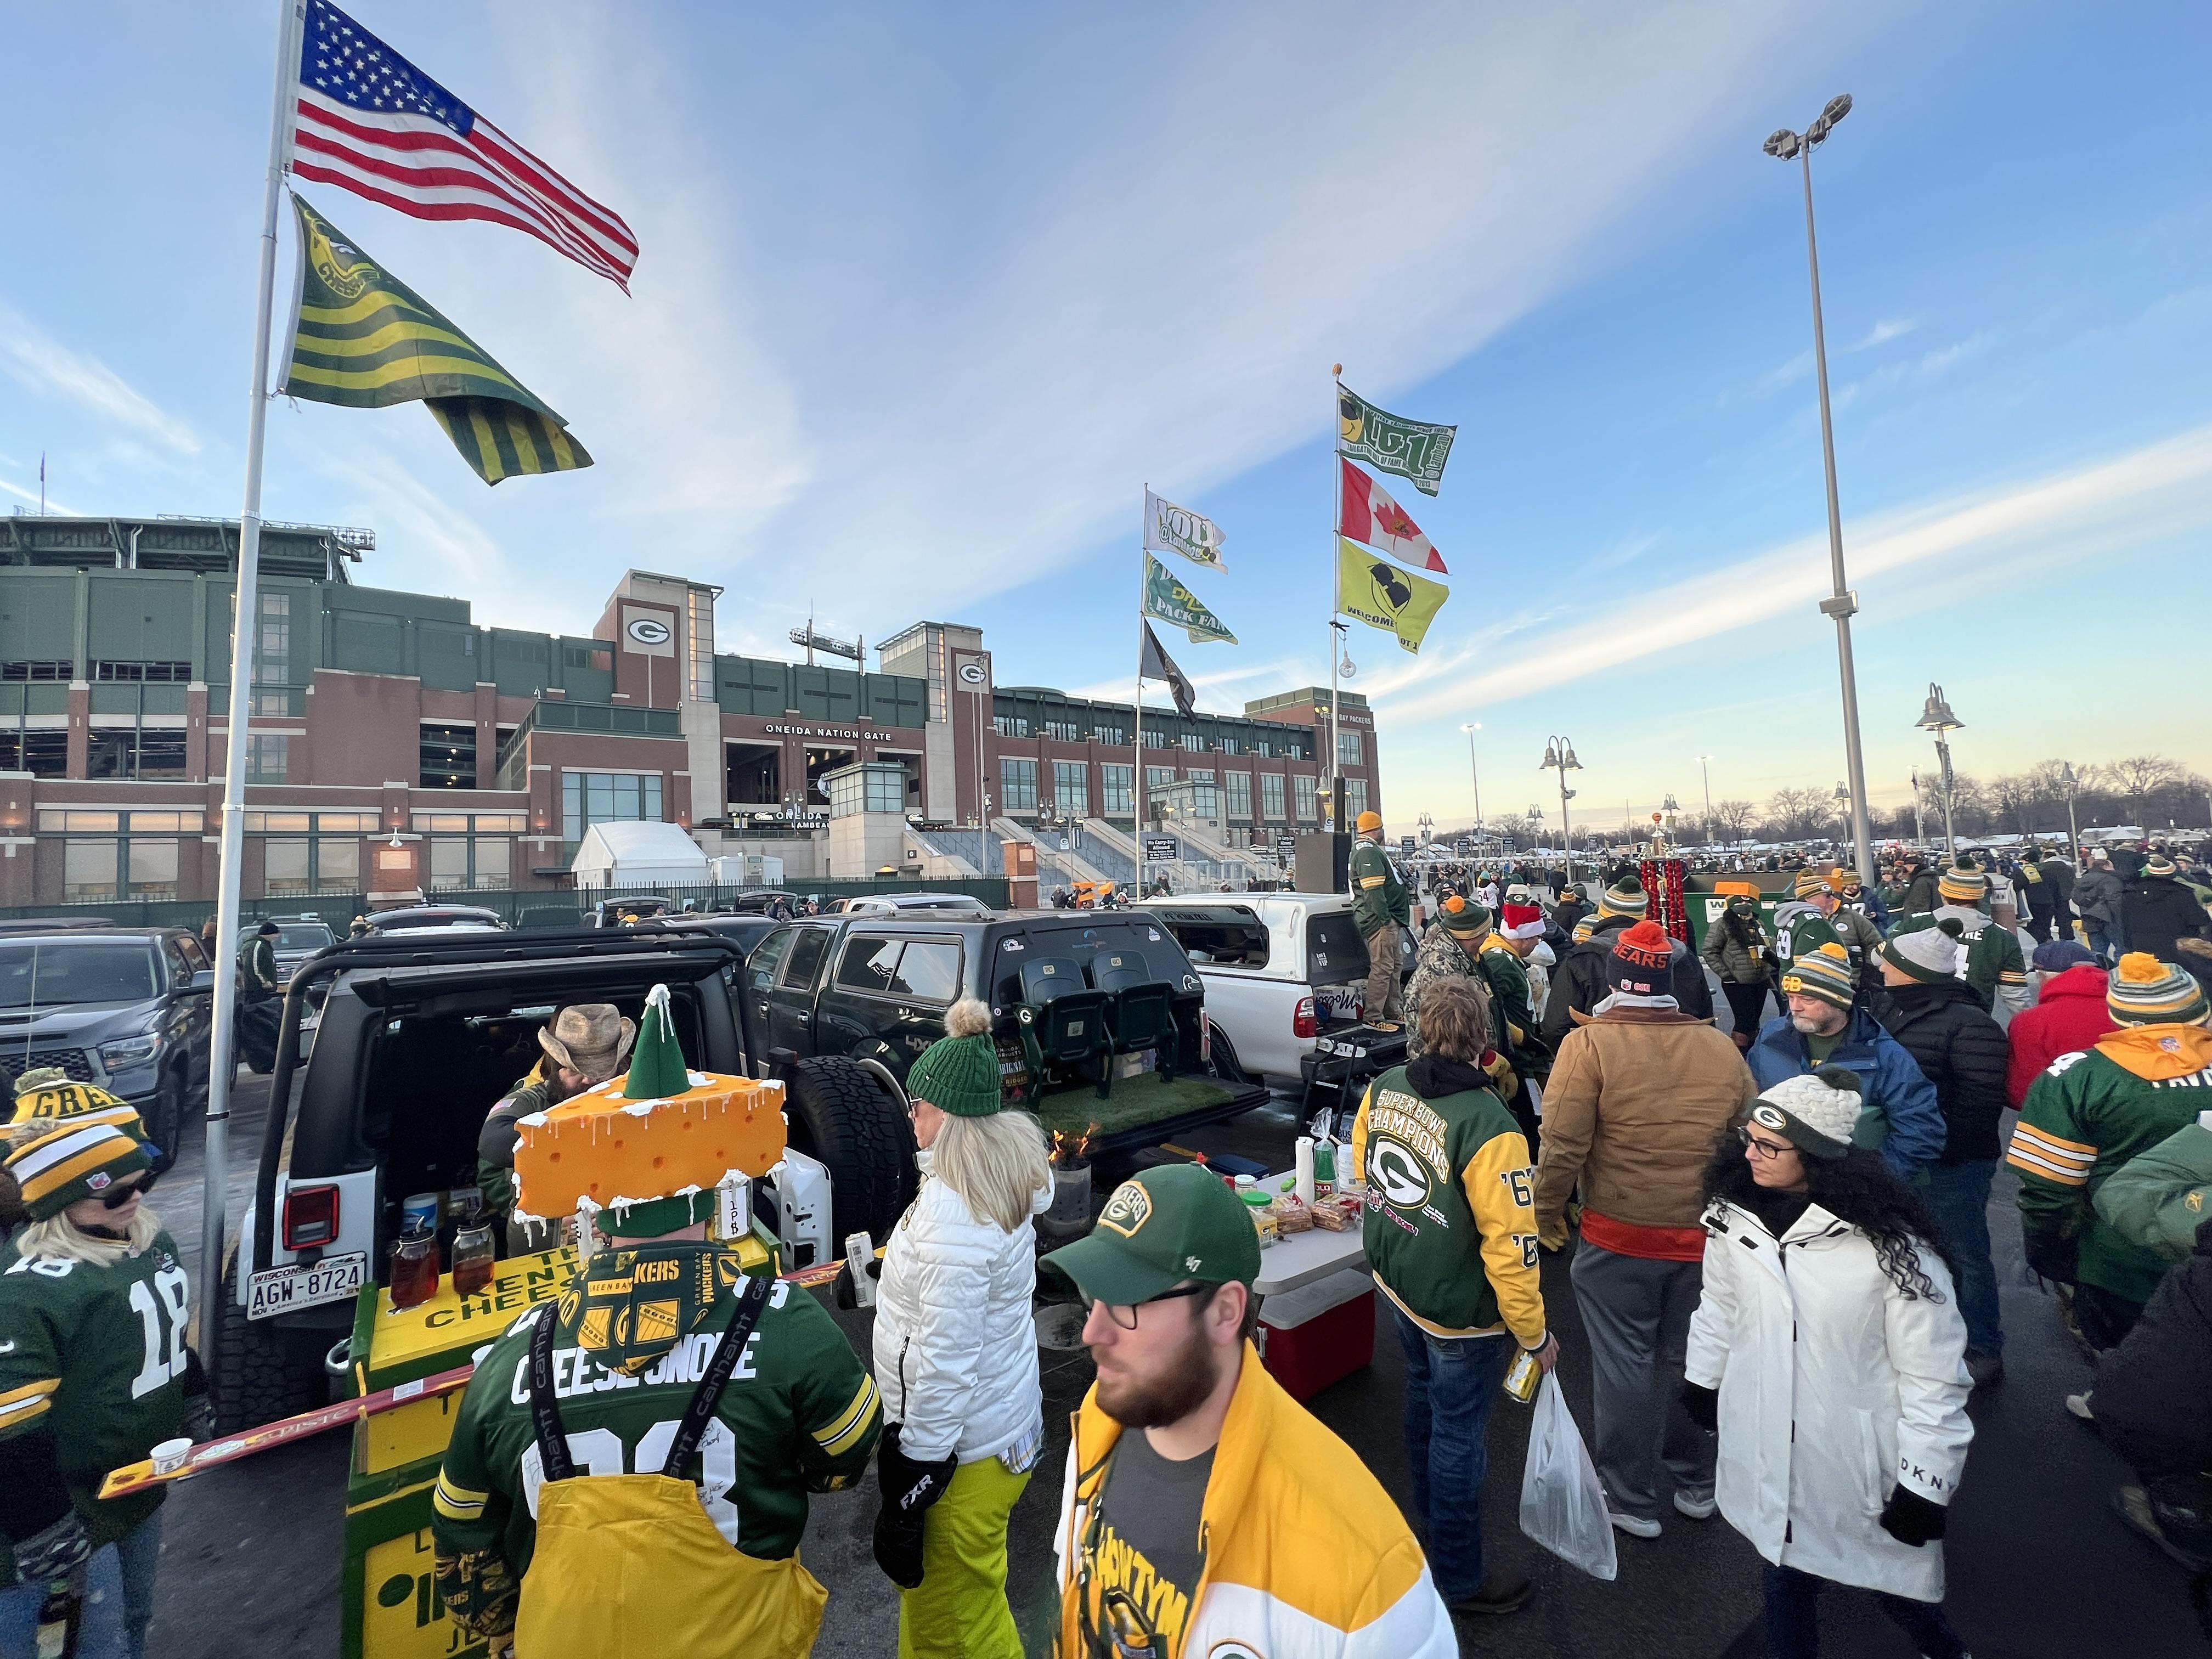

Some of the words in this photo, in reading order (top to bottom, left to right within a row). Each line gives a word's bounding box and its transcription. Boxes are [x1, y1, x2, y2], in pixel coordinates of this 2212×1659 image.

[1380, 456, 1387, 465] OF
[1387, 458, 1402, 467] FAME
[1156, 595, 1193, 623] PACK
[1347, 605, 1395, 627] WELCOME
[627, 619, 670, 645] G
[1400, 637, 1410, 647] OT
[959, 663, 986, 684] G
[1350, 715, 1372, 725] PACKERS
[765, 724, 811, 736] ONEIDA
[817, 728, 859, 739] NATION
[864, 731, 892, 741] GATE
[776, 811, 822, 821] ONEIDA
[1613, 943, 1668, 969] BEARS
[1019, 1008, 1032, 1025] G
[1376, 1088, 1418, 1115] SUPER
[1414, 1101, 1448, 1147] BOWL
[1753, 1105, 1786, 1129] G
[1368, 1108, 1449, 1184] CHAMPIONS
[1371, 1137, 1430, 1208] G
[532, 1248, 579, 1266] TH
[253, 1265, 315, 1283] WISCONSIN
[702, 1252, 714, 1304] PACKERS
[252, 1266, 359, 1309] AGW-8724
[252, 1308, 267, 1316] NOV
[696, 1311, 752, 1417] carhartt
[900, 1474, 933, 1510] FXR
